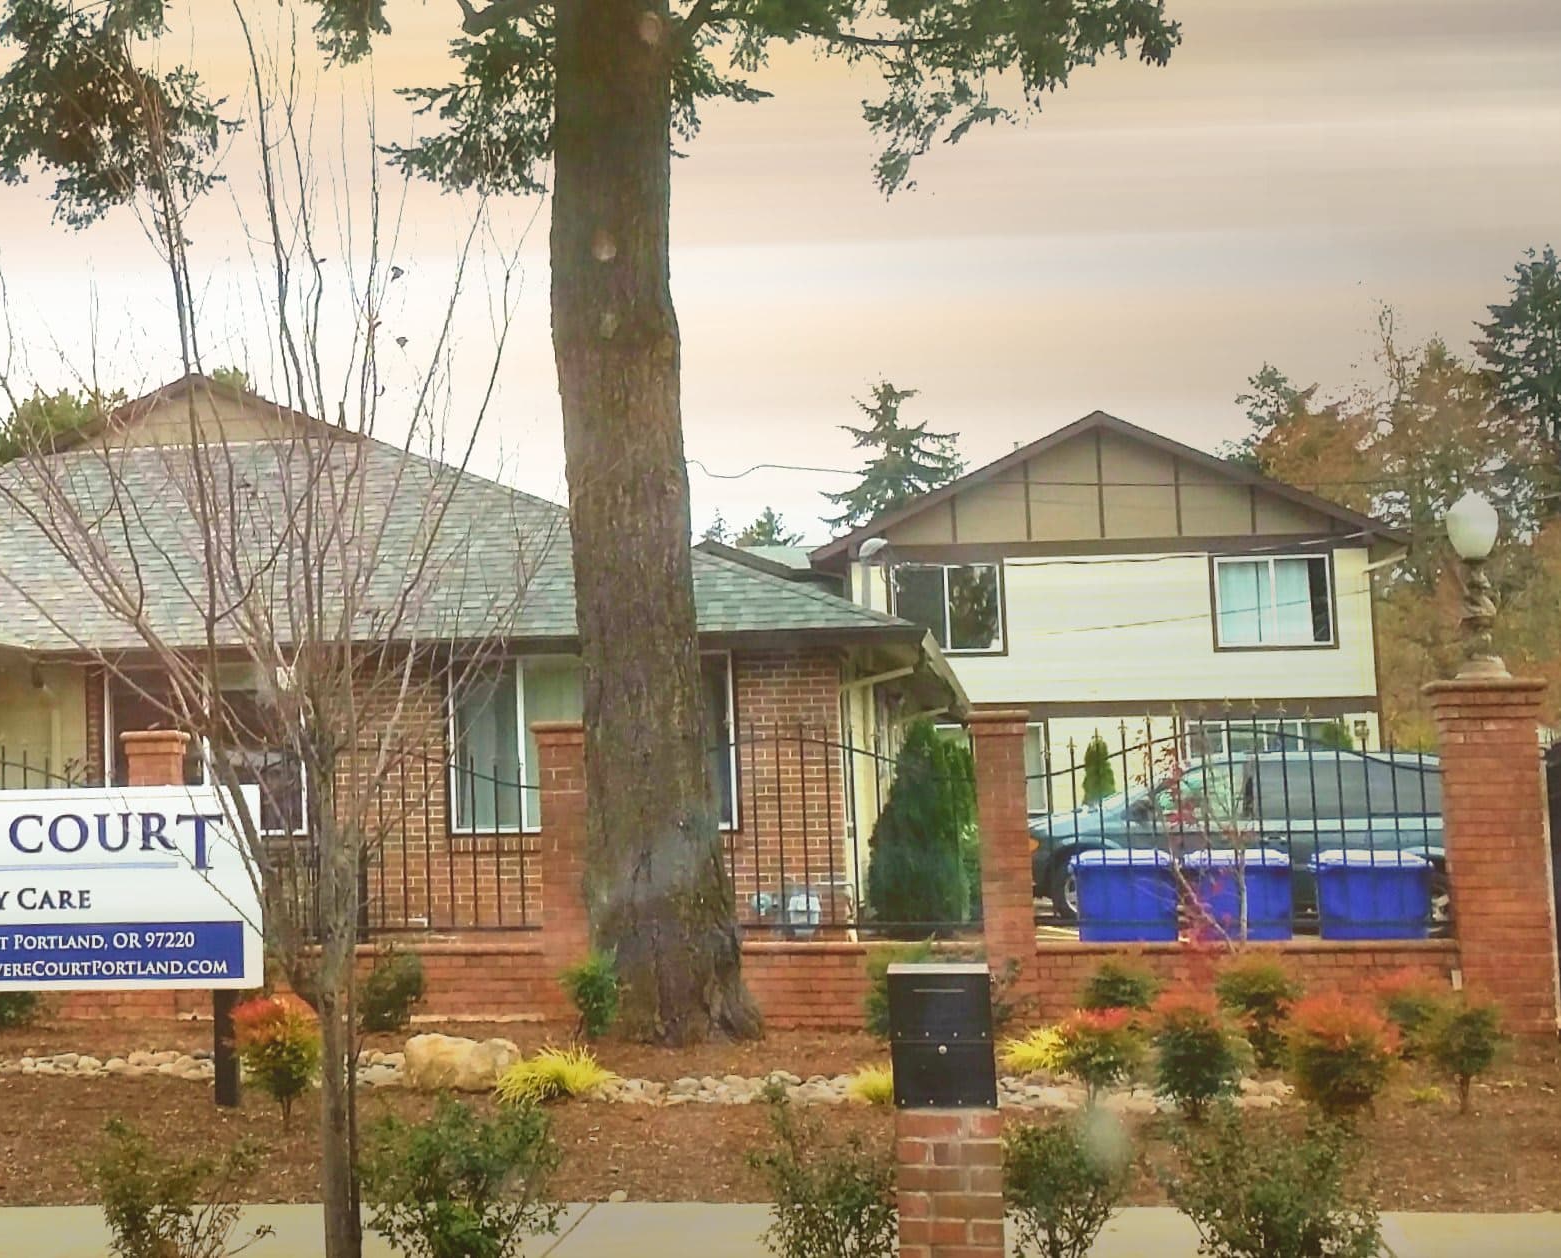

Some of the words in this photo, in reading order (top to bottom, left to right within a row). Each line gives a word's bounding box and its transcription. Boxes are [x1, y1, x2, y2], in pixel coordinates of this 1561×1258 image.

[8, 811, 224, 871] COURT
[16, 887, 91, 910] CARE
[14, 932, 108, 950] PORTLAND,
[113, 931, 141, 949] OR
[145, 931, 195, 949] 97220
